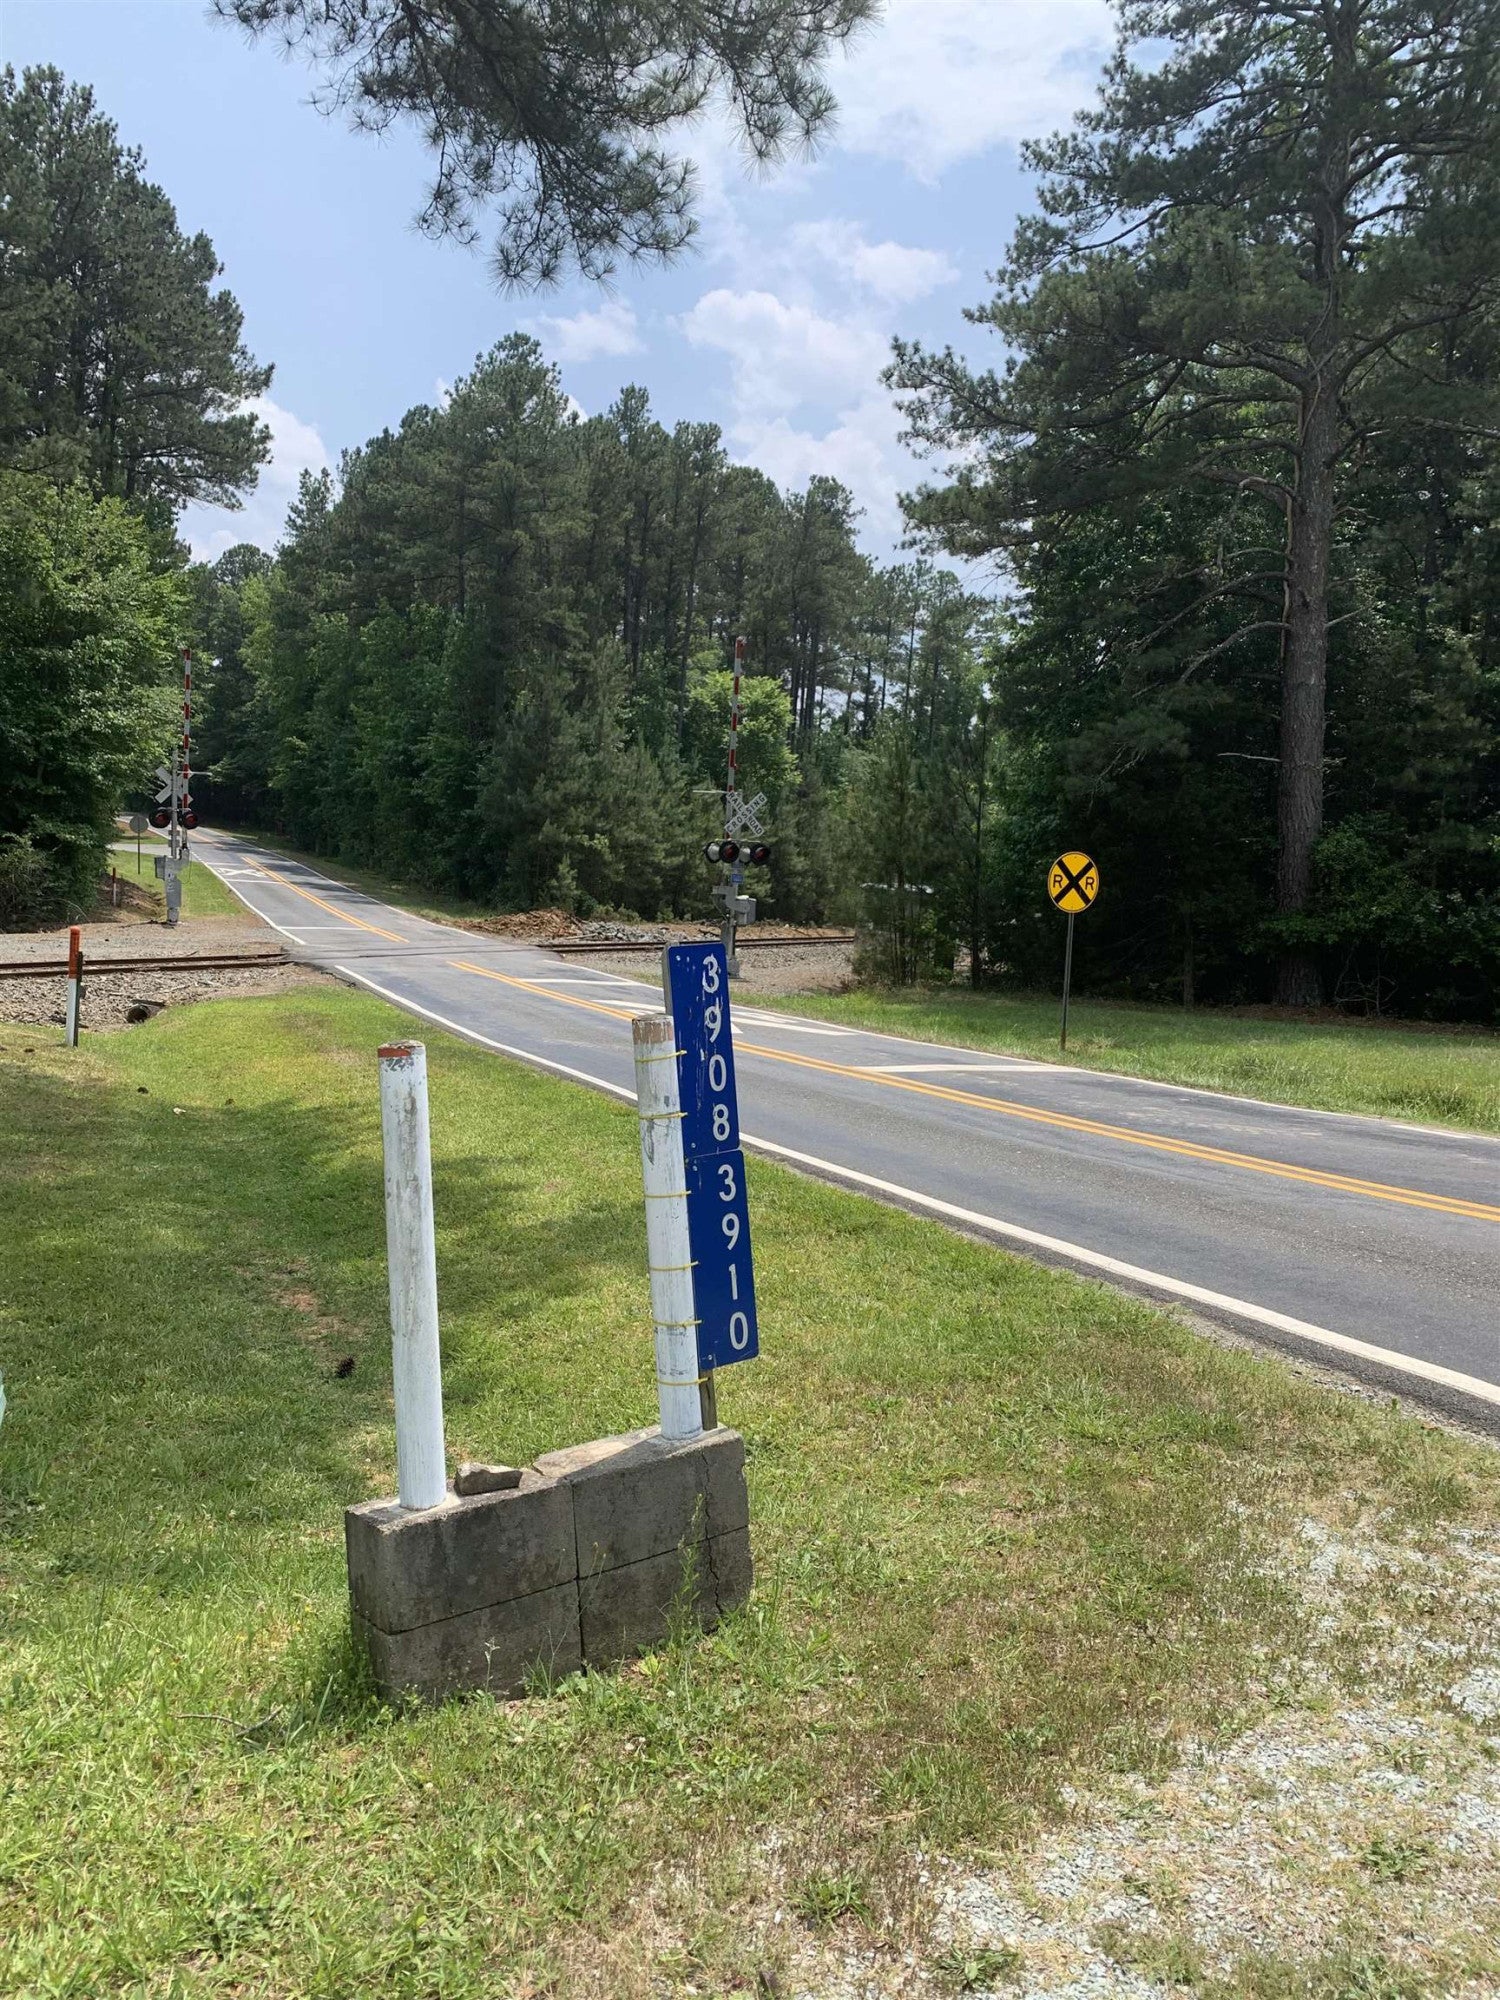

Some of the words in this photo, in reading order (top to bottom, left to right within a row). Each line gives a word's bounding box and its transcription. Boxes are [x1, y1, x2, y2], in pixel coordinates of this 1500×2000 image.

[726, 794, 765, 832] CROSSING
[702, 953, 730, 1141] 3908
[717, 1164, 749, 1350] 3910
